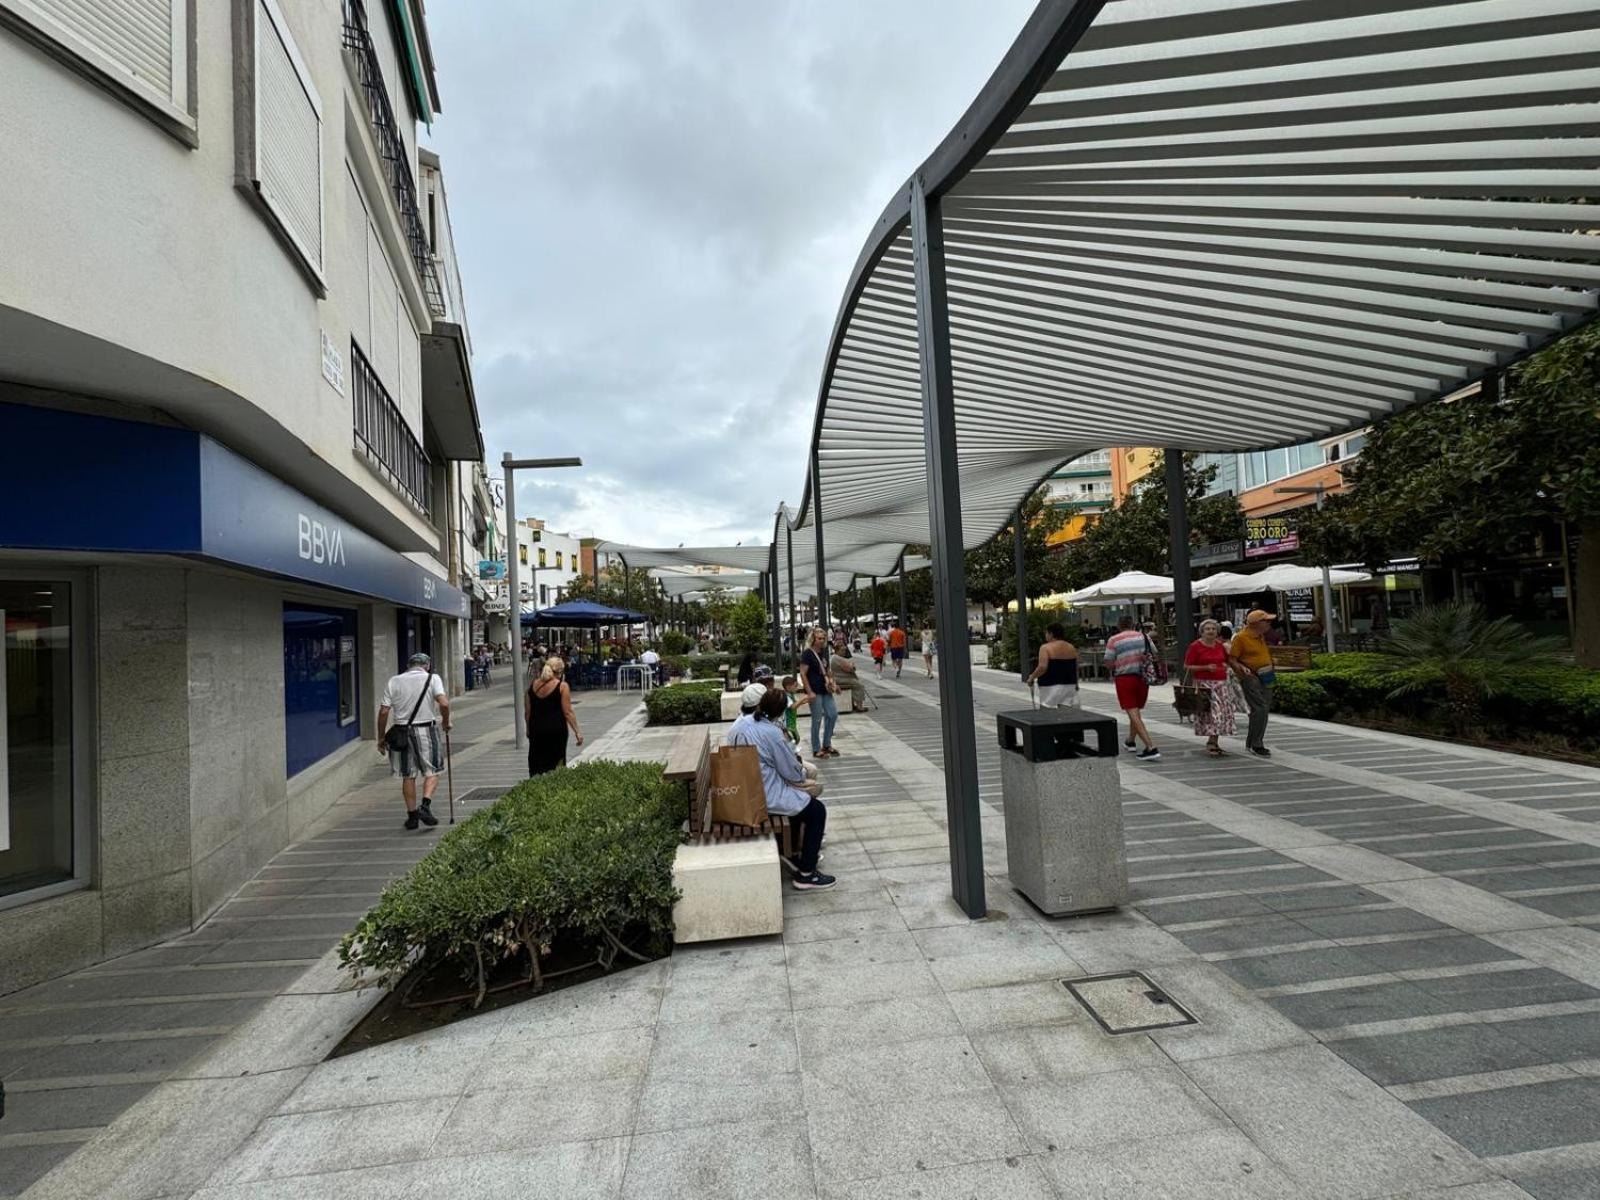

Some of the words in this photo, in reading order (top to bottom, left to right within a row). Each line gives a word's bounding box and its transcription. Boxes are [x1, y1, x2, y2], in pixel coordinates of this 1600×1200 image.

[1246, 519, 1267, 529] COMPRO
[298, 513, 346, 567] BBVA
[1247, 527, 1267, 540] ORO
[1267, 526, 1288, 539] ORO
